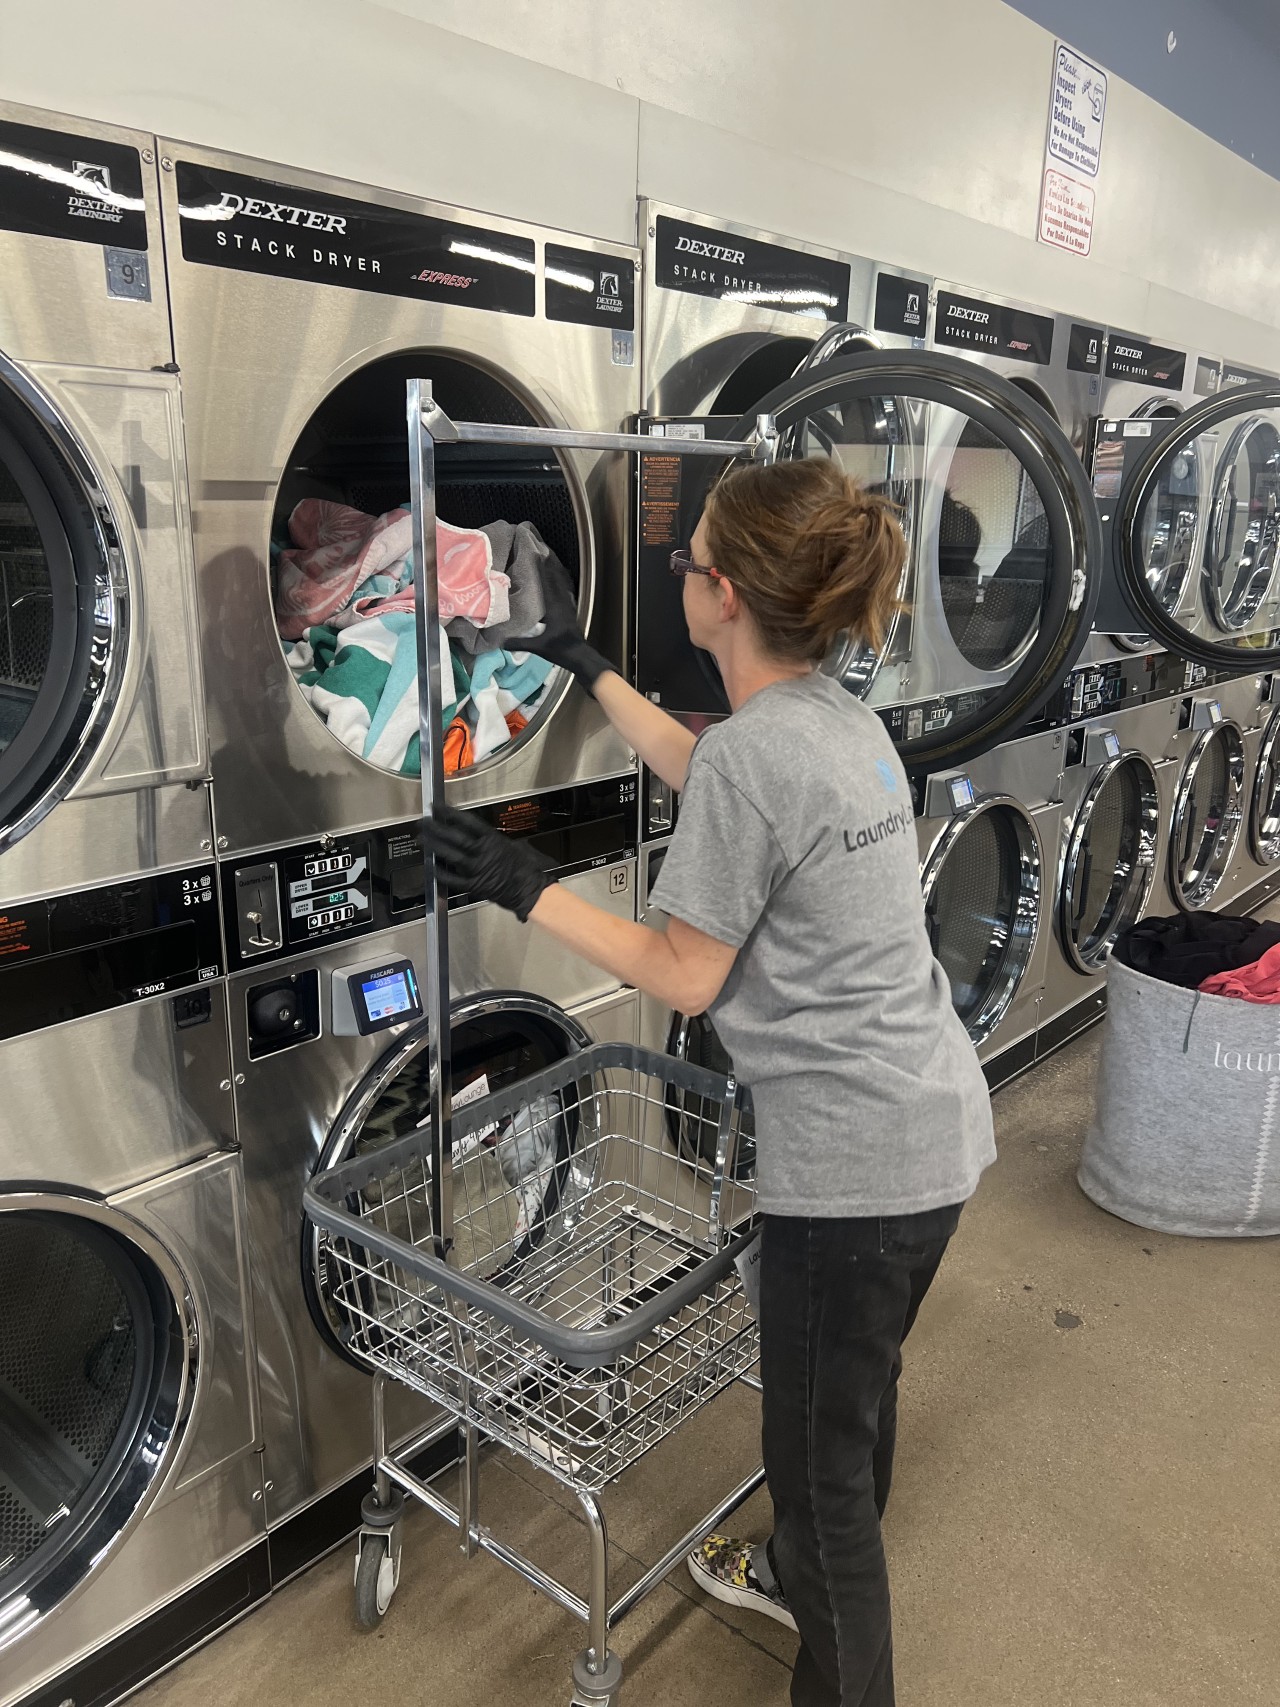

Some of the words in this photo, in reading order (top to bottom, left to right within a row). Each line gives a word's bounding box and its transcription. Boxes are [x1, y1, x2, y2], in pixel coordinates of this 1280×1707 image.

[1057, 72, 1075, 95] Inspect
[1055, 89, 1072, 111] Dryers
[1053, 106, 1070, 127] Before
[1072, 116, 1085, 138] Using
[1053, 125, 1059, 136] We
[1075, 138, 1098, 158] Responsible
[1058, 143, 1074, 159] Damage
[1075, 151, 1080, 162] To
[1080, 155, 1096, 172] Clothing
[67, 196, 122, 214] DEXTER
[218, 192, 347, 235] DEXTER
[68, 207, 124, 223] LAUNDRY
[216, 231, 296, 259] STACK
[313, 249, 381, 274] DRYER
[674, 236, 746, 265] DEXTER
[121, 264, 135, 285] 9
[417, 269, 473, 289] EXPRESS
[673, 264, 716, 283] STACK
[724, 275, 761, 292] DRYER
[595, 304, 624, 313] LAUNDRY
[596, 296, 623, 306] DEXTER
[947, 305, 990, 324] DEXTER
[945, 326, 970, 339] STACK
[974, 332, 998, 345] DRYER
[1114, 345, 1143, 359] DEXTER
[620, 784, 624, 792] 3
[620, 795, 624, 803] 3
[182, 880, 190, 890] 3
[192, 881, 198, 889] x
[613, 872, 625, 886] 12
[183, 895, 191, 906] 3
[193, 896, 200, 904] x
